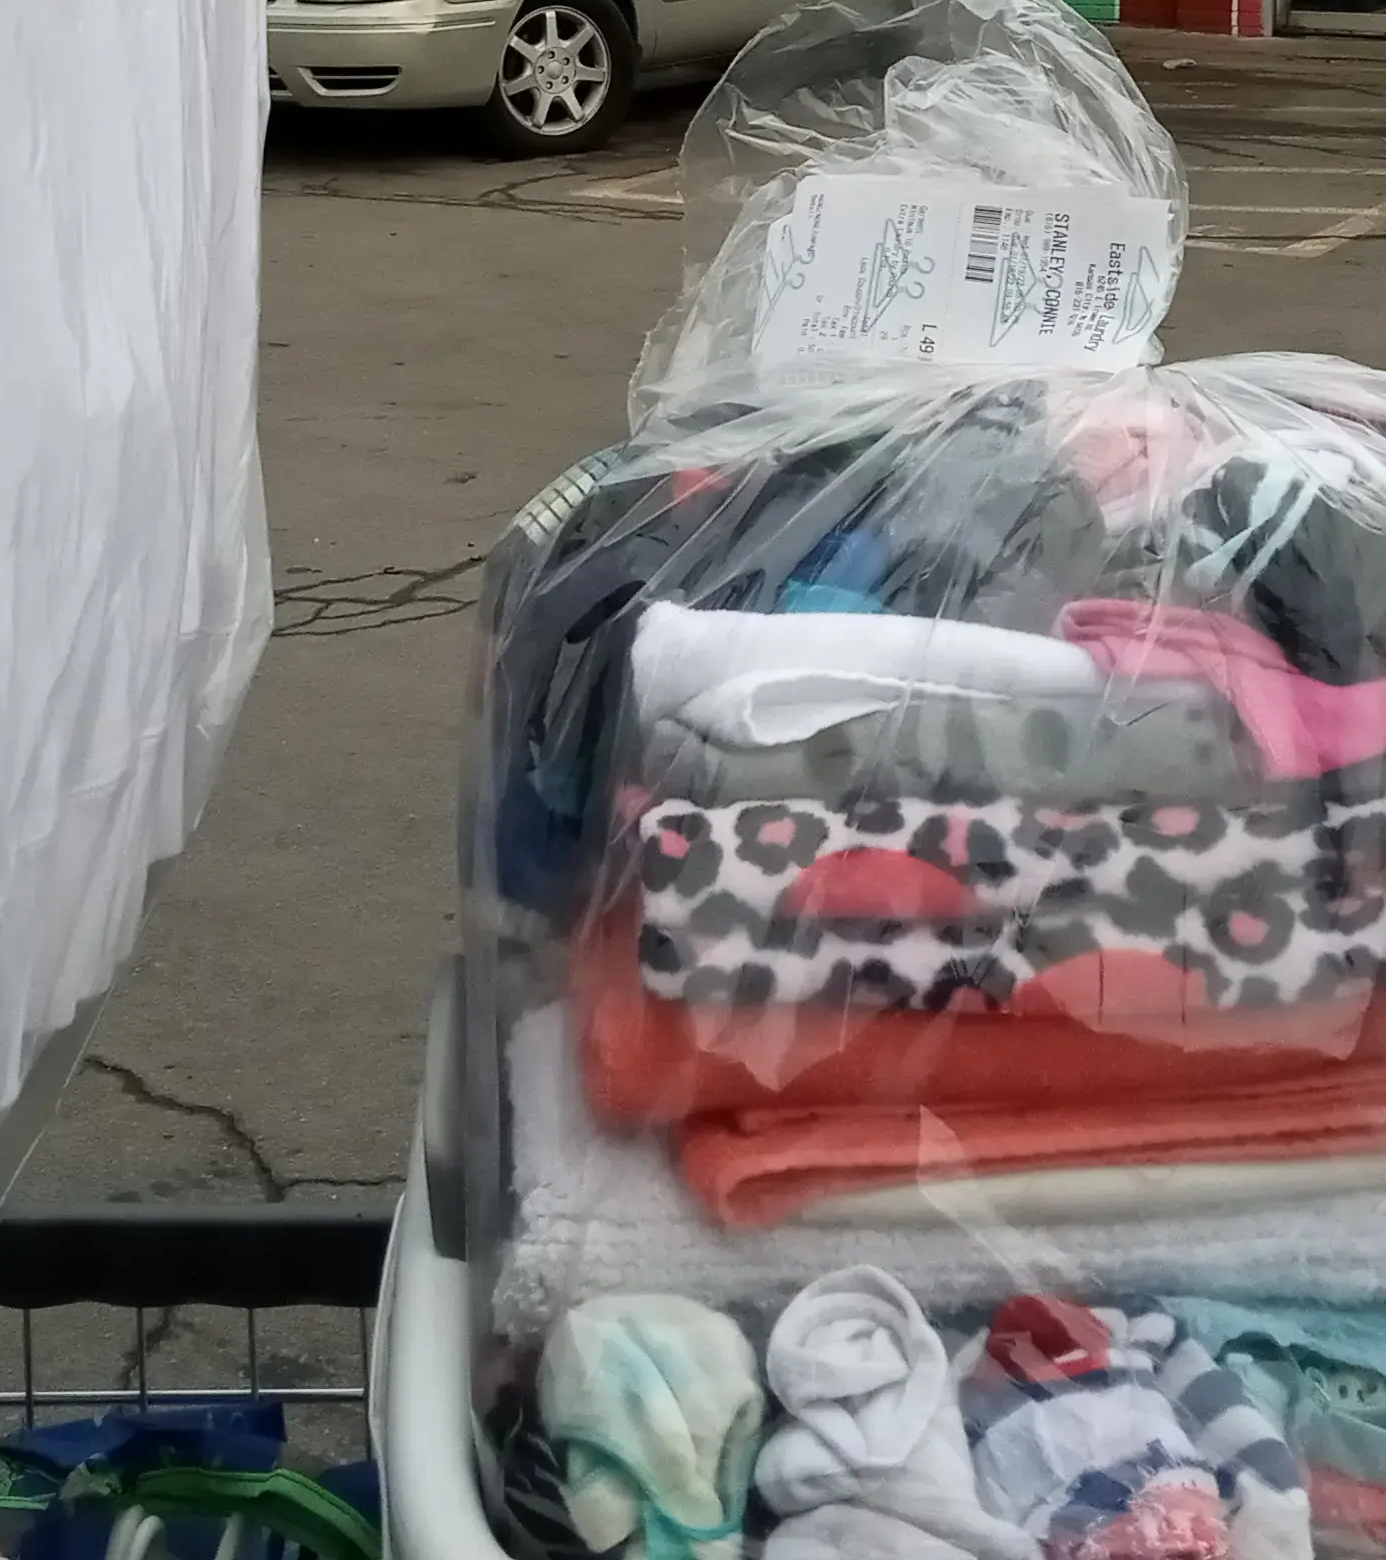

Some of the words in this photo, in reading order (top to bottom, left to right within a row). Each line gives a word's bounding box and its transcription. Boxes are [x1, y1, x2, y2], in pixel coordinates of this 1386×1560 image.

[1046, 213, 1070, 279] STANLEY,
[1104, 242, 1126, 310] Eastside
[921, 324, 938, 332] L
[1039, 289, 1061, 336] CONNIE
[1084, 315, 1114, 352] Laundry
